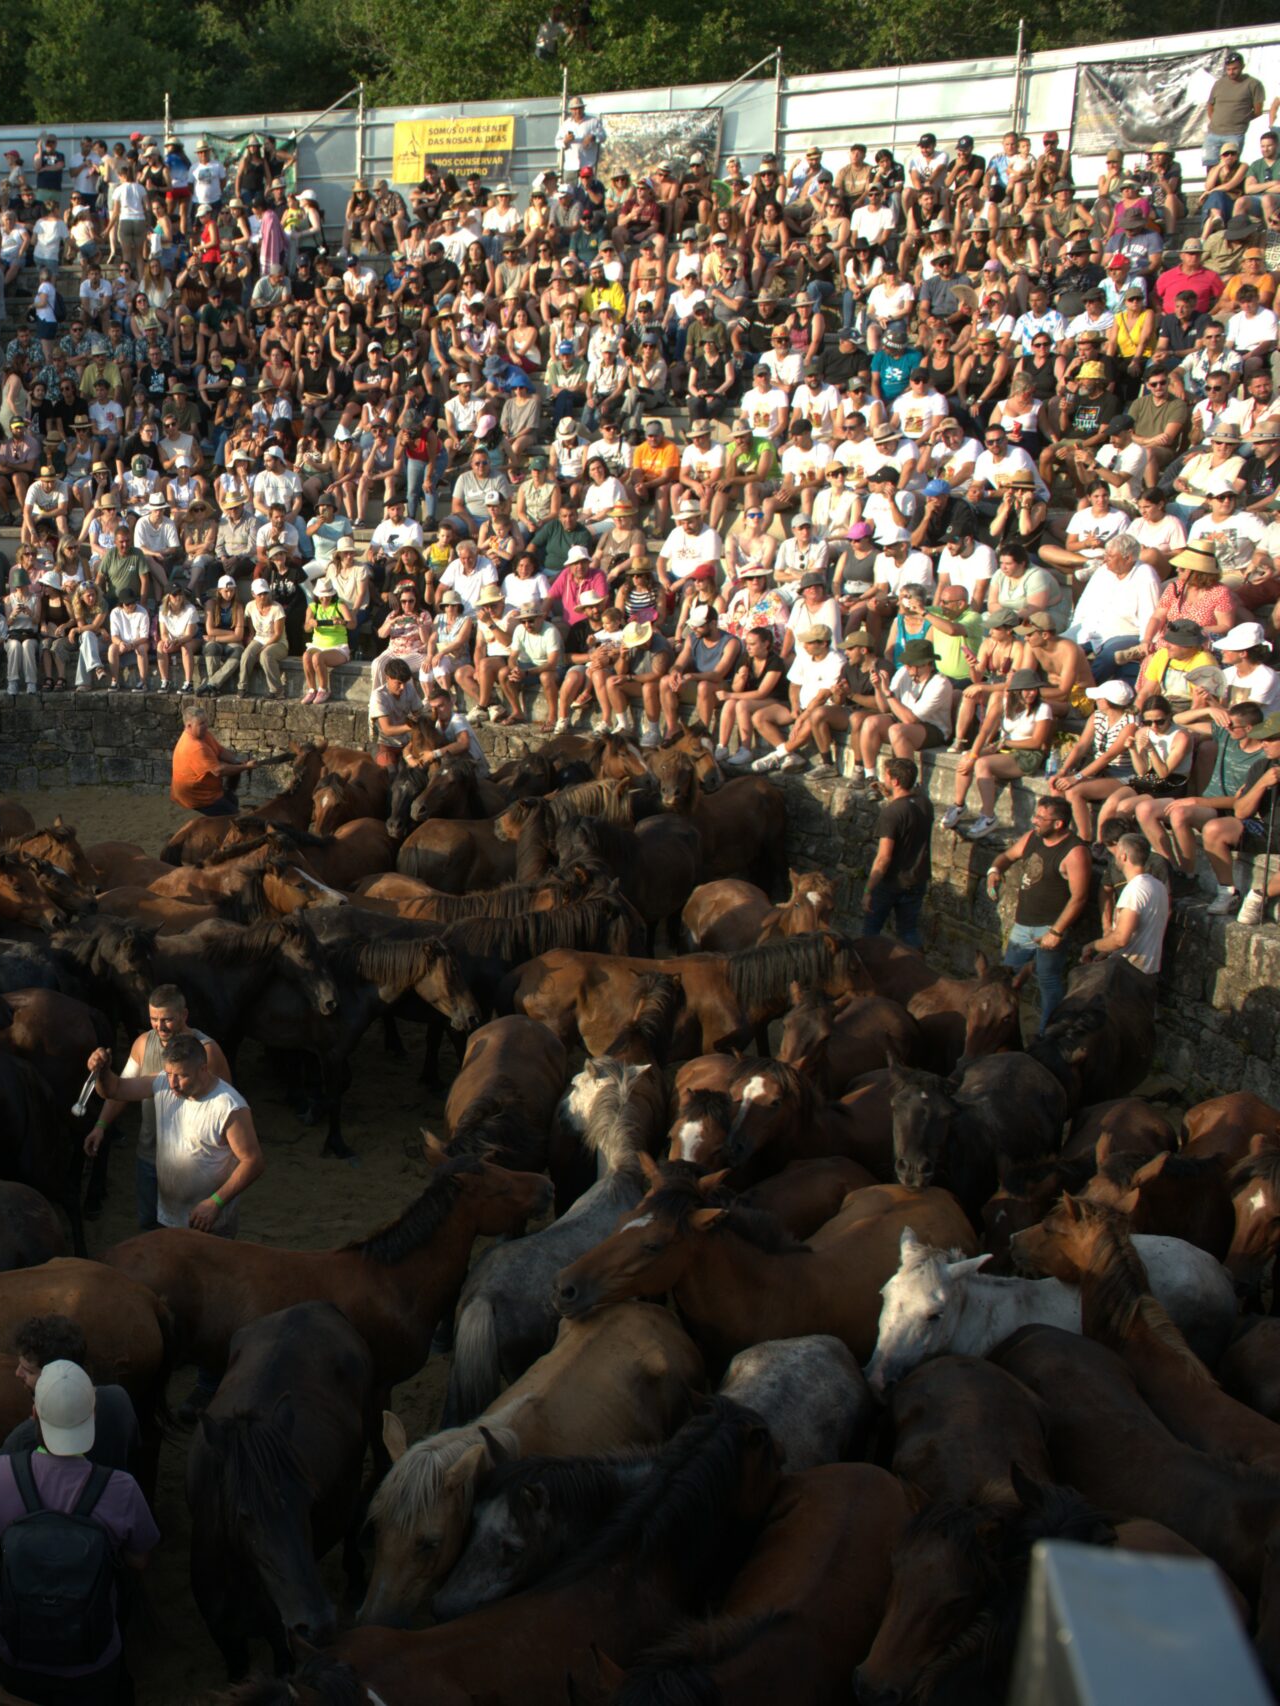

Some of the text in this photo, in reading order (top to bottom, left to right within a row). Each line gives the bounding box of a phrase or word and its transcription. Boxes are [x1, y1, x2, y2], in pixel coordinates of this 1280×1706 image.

[428, 126, 456, 135] SOMOS
[466, 124, 507, 133] PRESENTE
[446, 136, 473, 144] NOSAS
[454, 156, 503, 166] CONSERVAR
